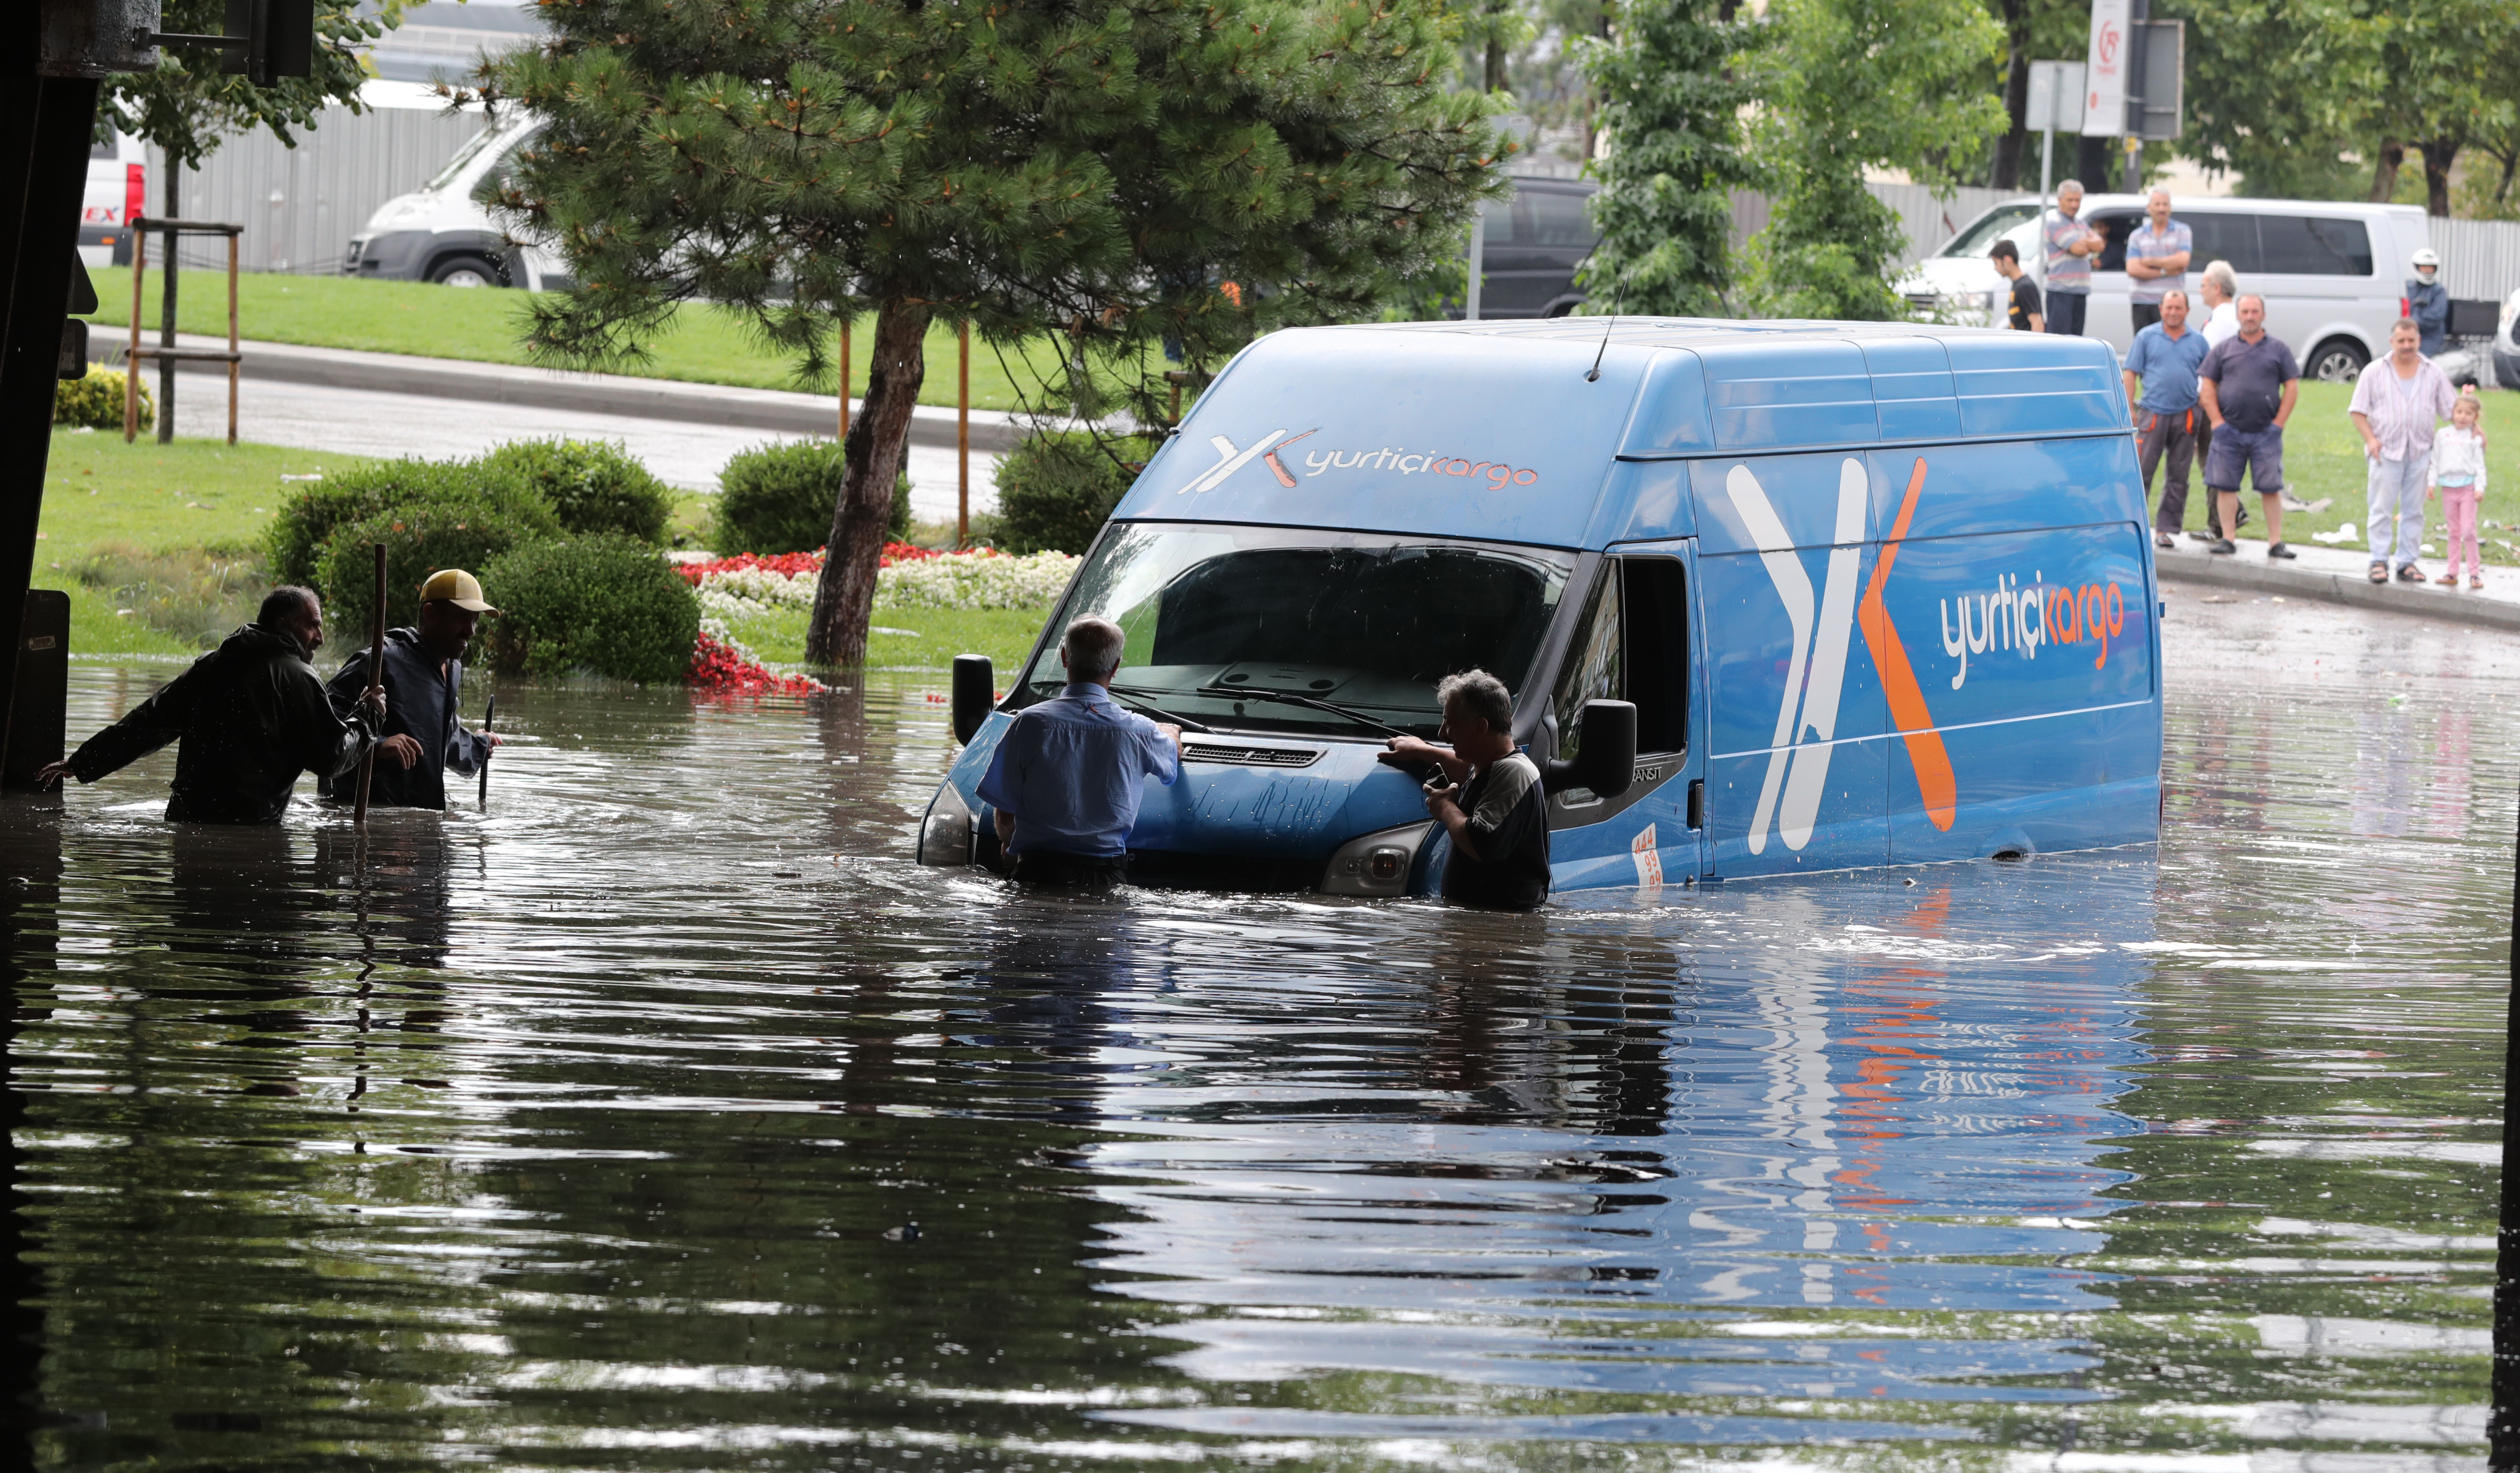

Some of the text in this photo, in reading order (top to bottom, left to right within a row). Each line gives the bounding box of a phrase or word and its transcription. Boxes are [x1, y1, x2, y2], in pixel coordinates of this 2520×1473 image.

[82, 206, 120, 222] EX
[1636, 828, 1652, 856] 444
[1644, 850, 1656, 872] 99
